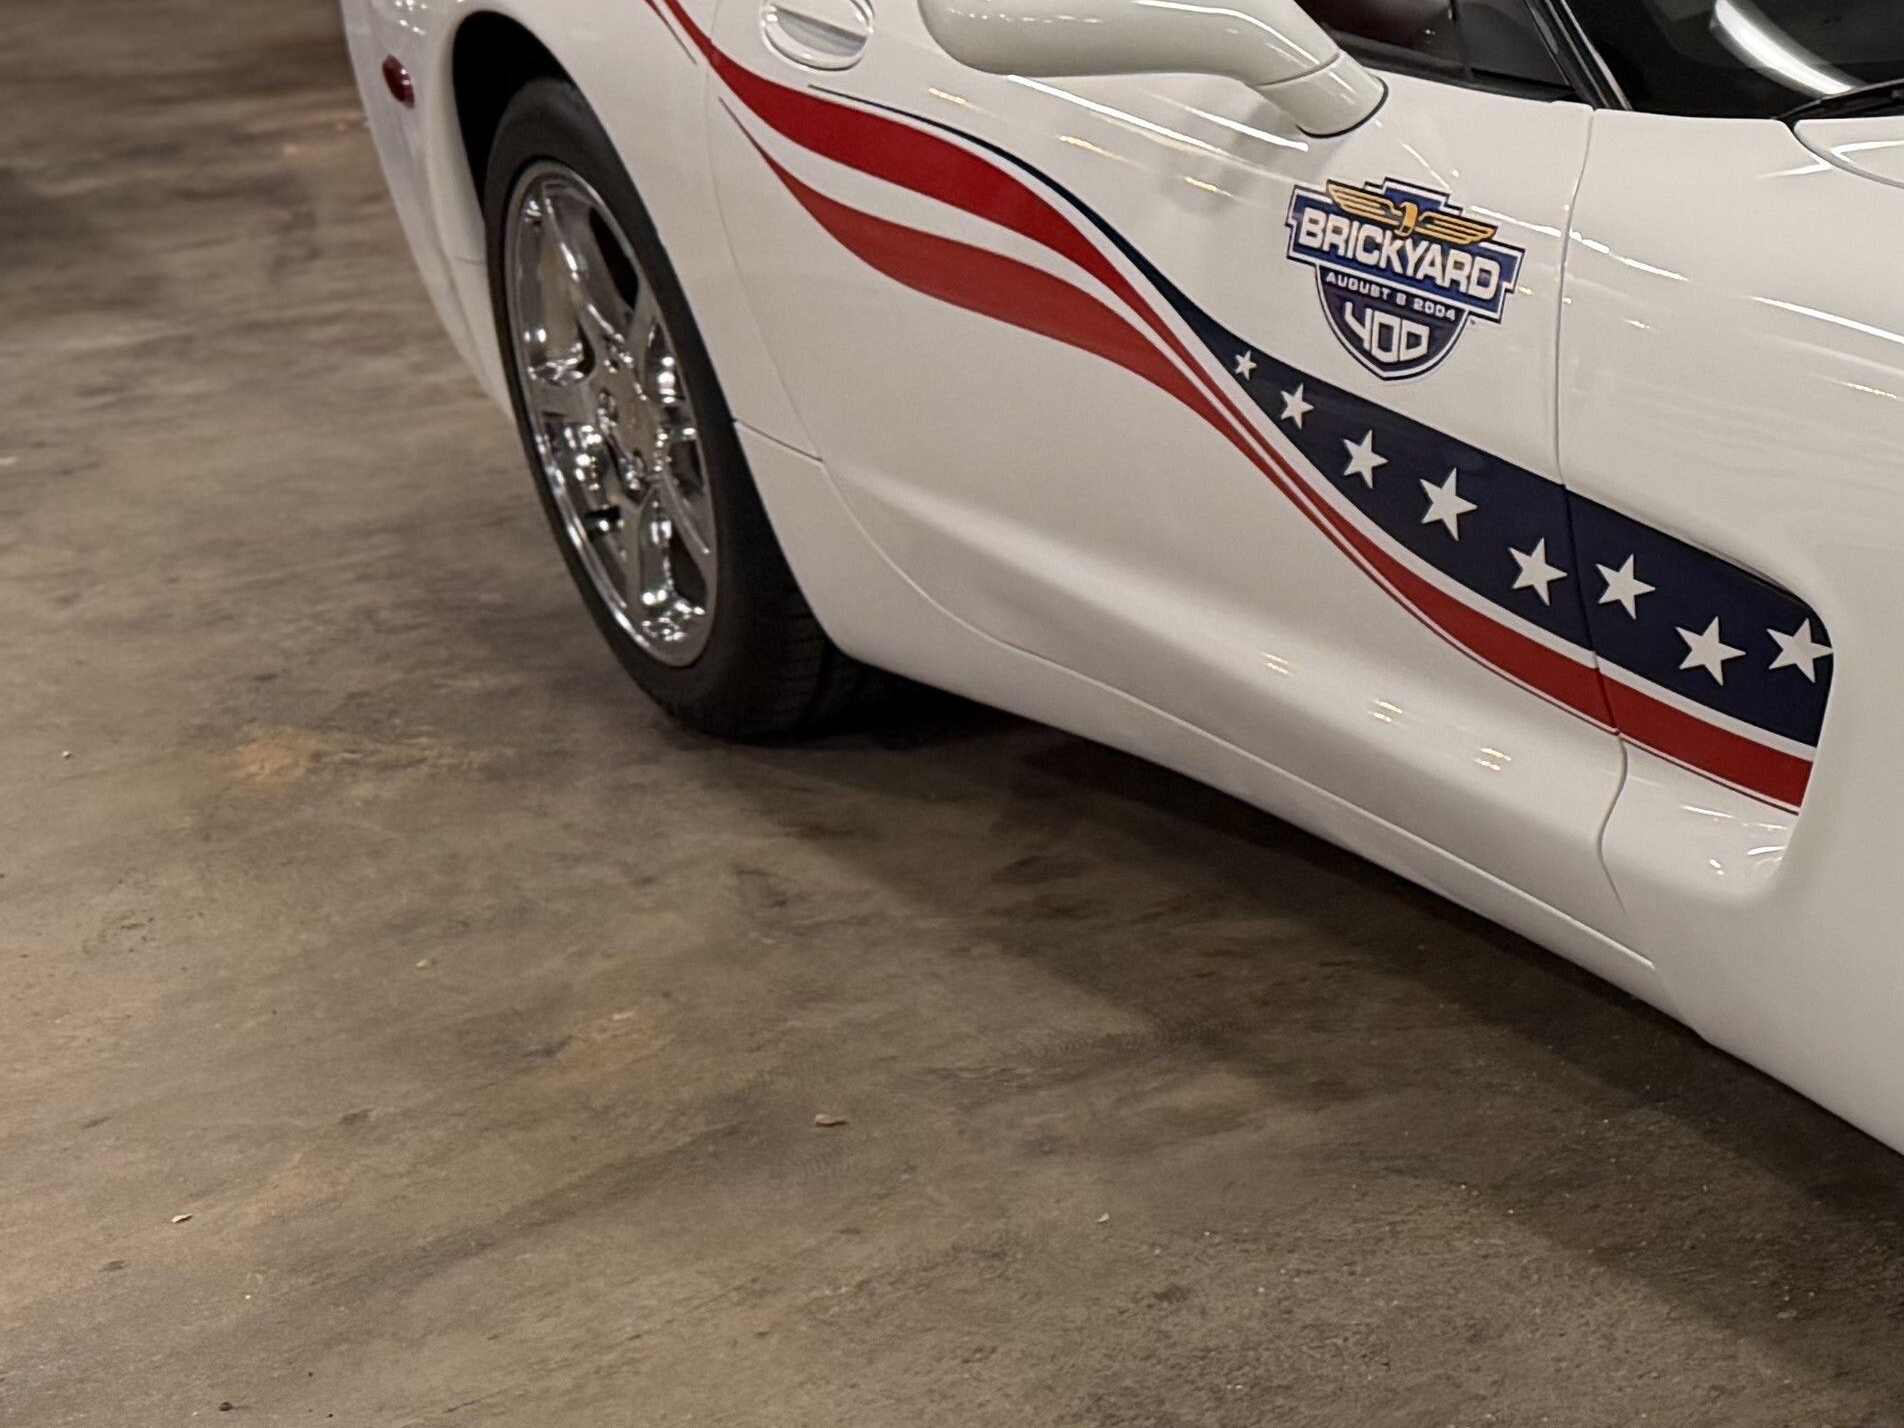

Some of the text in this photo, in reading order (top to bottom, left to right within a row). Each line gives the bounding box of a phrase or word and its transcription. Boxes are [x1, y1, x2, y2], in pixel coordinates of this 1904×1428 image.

[1298, 207, 1501, 301] BRICKYARD
[1325, 271, 1391, 301] AUGUST
[1413, 299, 1456, 322] 2004
[1344, 301, 1431, 364] 400
